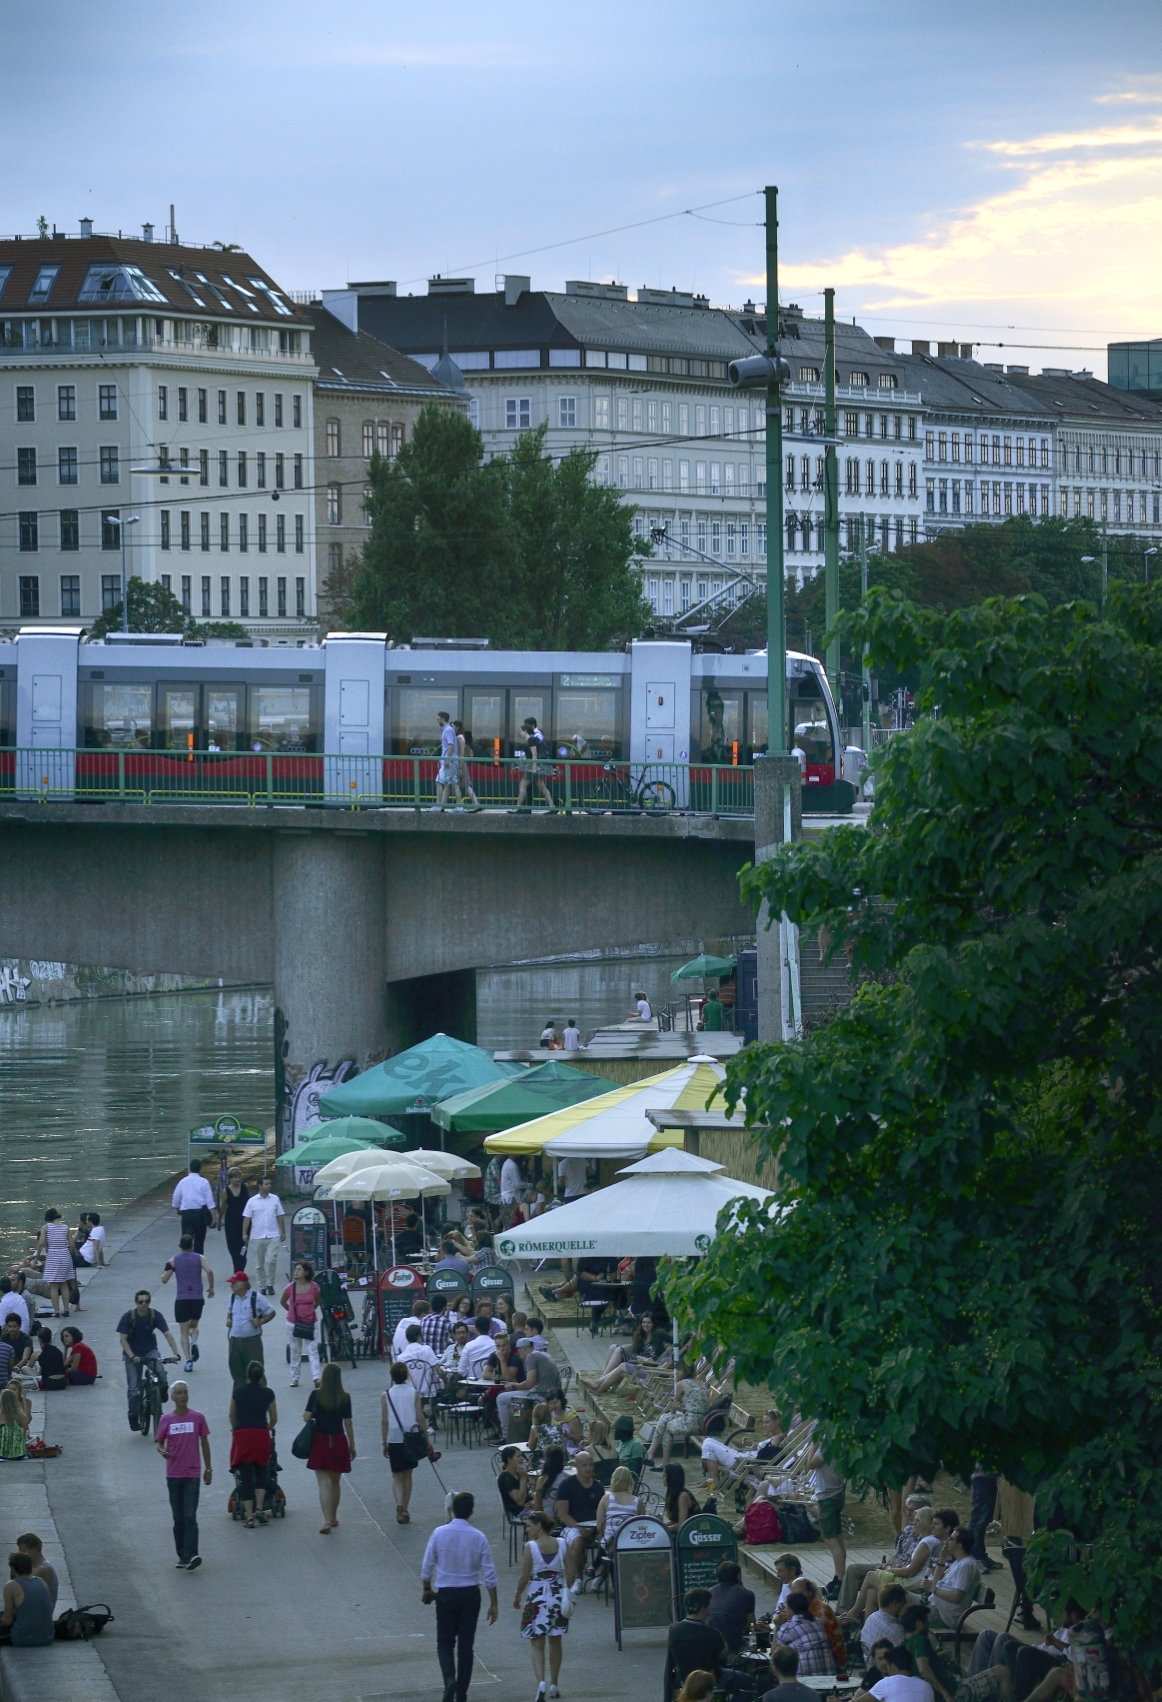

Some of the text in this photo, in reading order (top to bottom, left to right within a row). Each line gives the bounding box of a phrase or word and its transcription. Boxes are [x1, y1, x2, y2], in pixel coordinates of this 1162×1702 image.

[563, 674, 570, 686] 2
[518, 1240, 595, 1252] RÖMERQUELLE
[436, 1279, 459, 1289] Gösser
[480, 1276, 503, 1287] Gösser
[630, 1530, 656, 1540] Zipfer
[689, 1530, 722, 1545] Gösser
